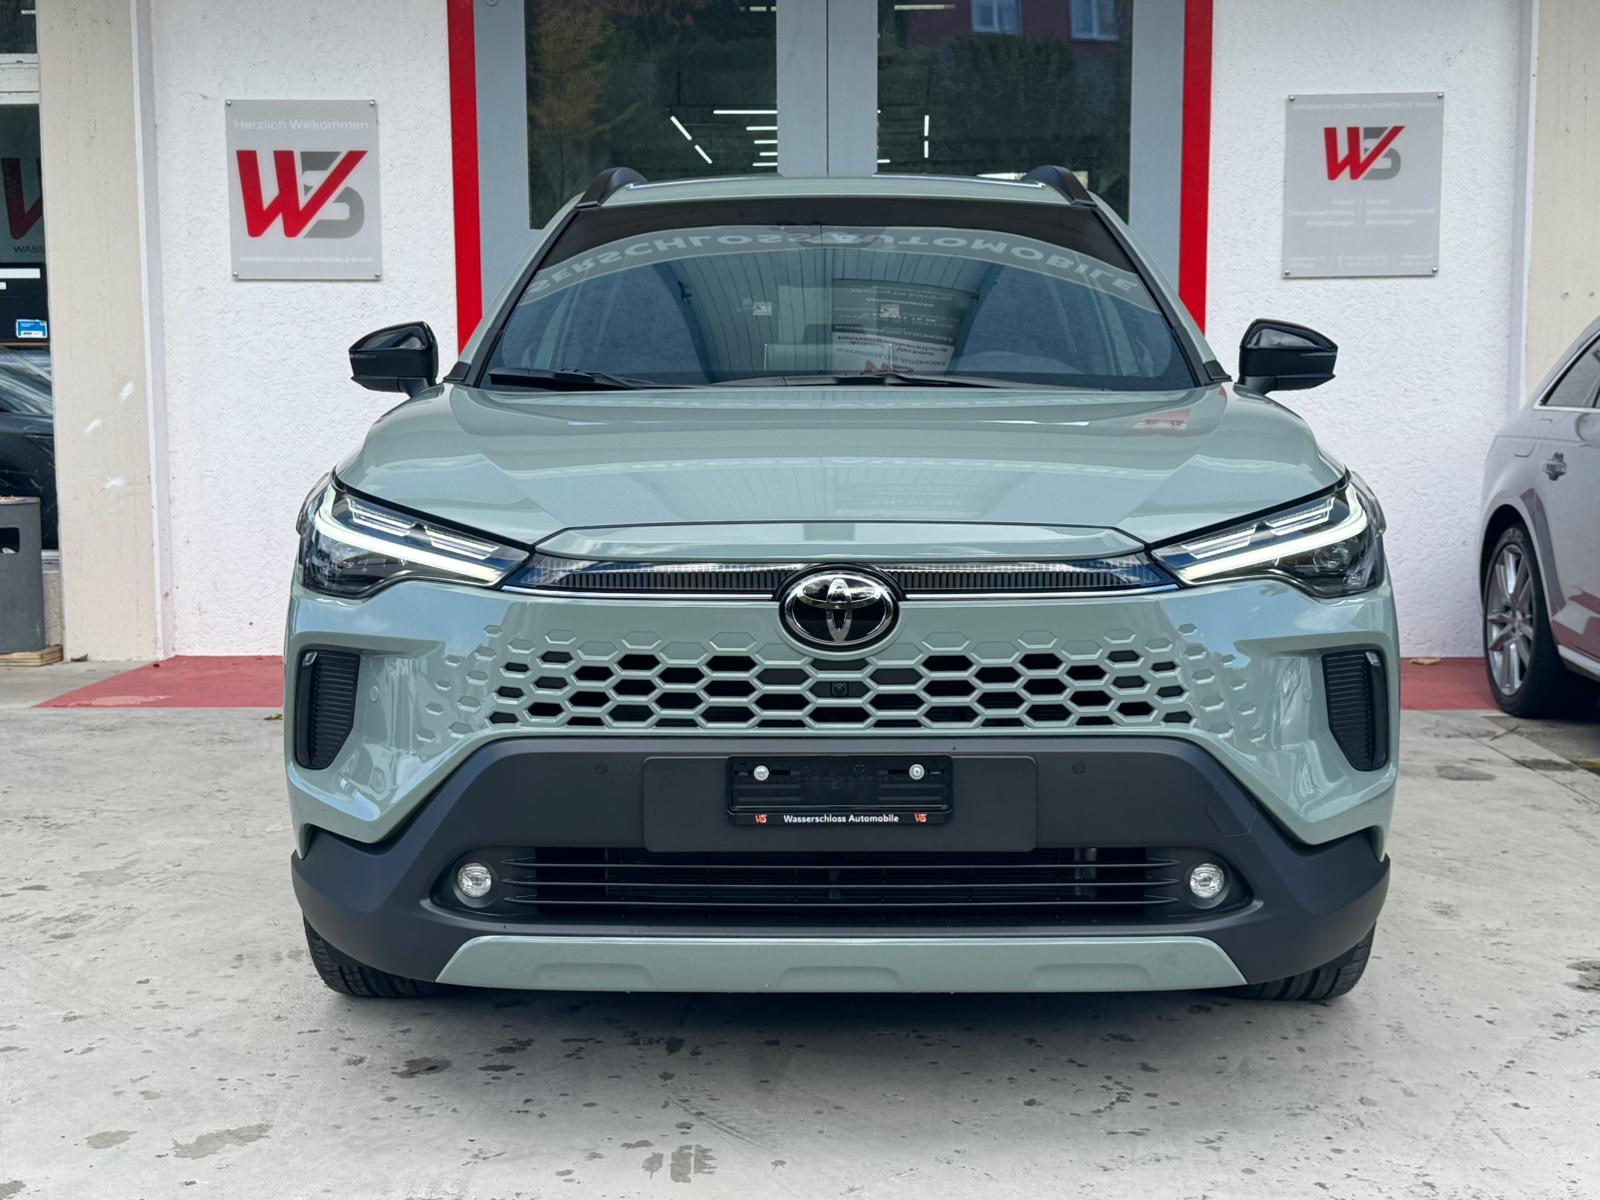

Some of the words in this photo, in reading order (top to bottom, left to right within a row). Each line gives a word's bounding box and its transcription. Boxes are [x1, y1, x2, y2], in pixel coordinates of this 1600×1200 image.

[234, 119, 287, 130] Herzlich
[289, 119, 369, 130] Willkommen
[783, 814, 846, 823] Wasserschloss
[848, 814, 899, 823] Automobile
